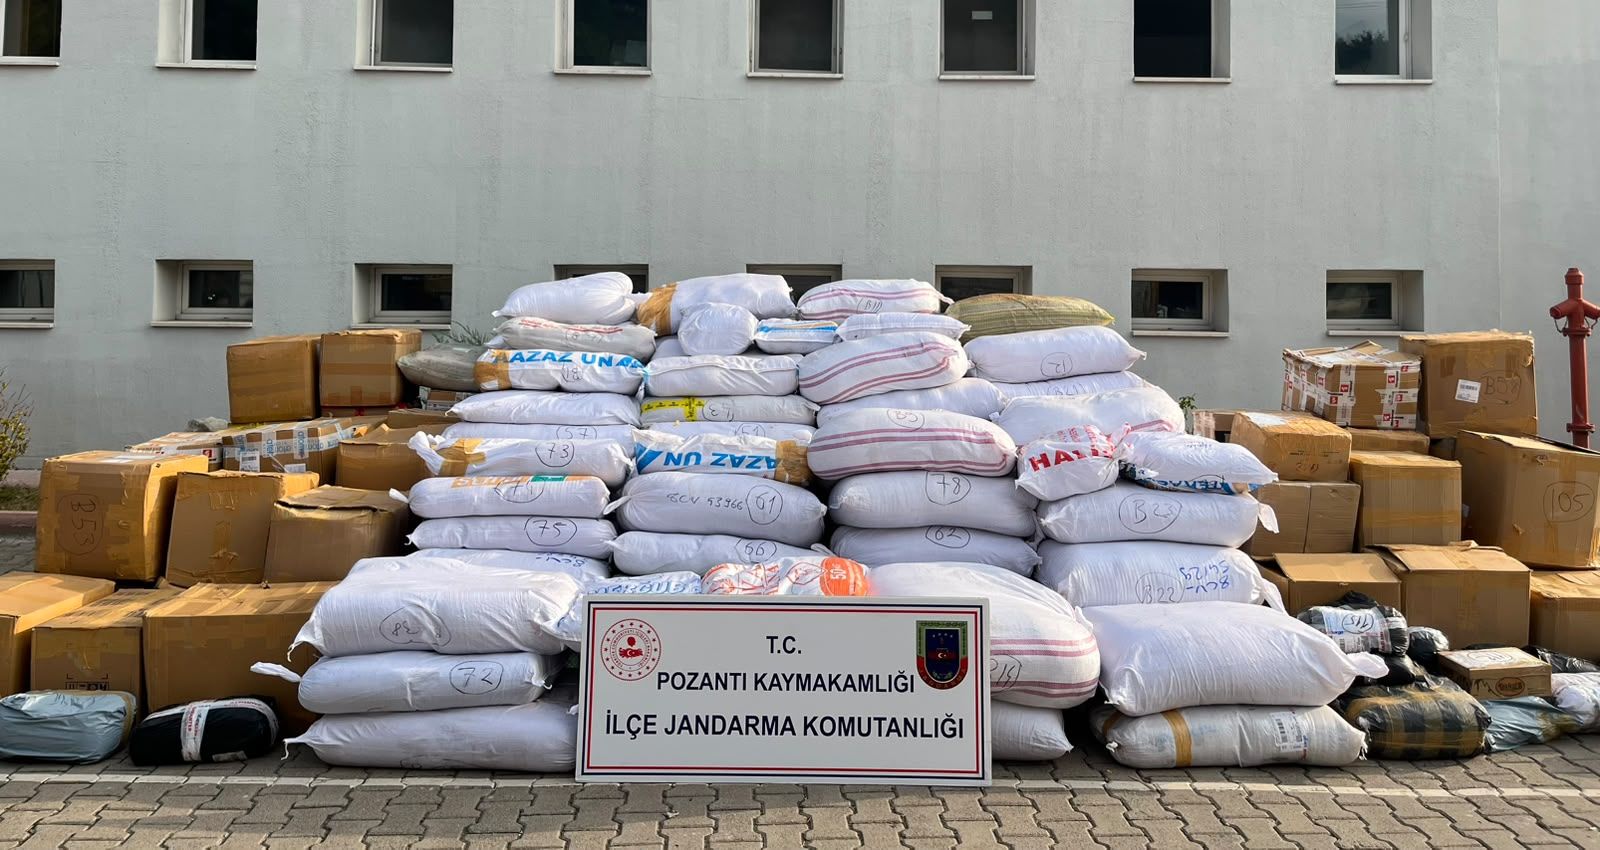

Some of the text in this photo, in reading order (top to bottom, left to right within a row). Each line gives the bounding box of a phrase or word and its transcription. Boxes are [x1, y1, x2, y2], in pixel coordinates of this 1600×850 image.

[545, 442, 570, 460] 73
[930, 473, 962, 498] 78
[755, 491, 776, 514] 61
[1551, 487, 1591, 521] 105
[532, 519, 567, 538] 75
[935, 526, 963, 542] 62
[744, 542, 765, 557] 66
[766, 635, 802, 654] T.C.
[457, 666, 494, 688] 72
[657, 669, 915, 693] POZANTI KAYMAKAMLIĞI
[605, 709, 964, 741] İLÇE JANDARMA KOMUTANLIĞI
